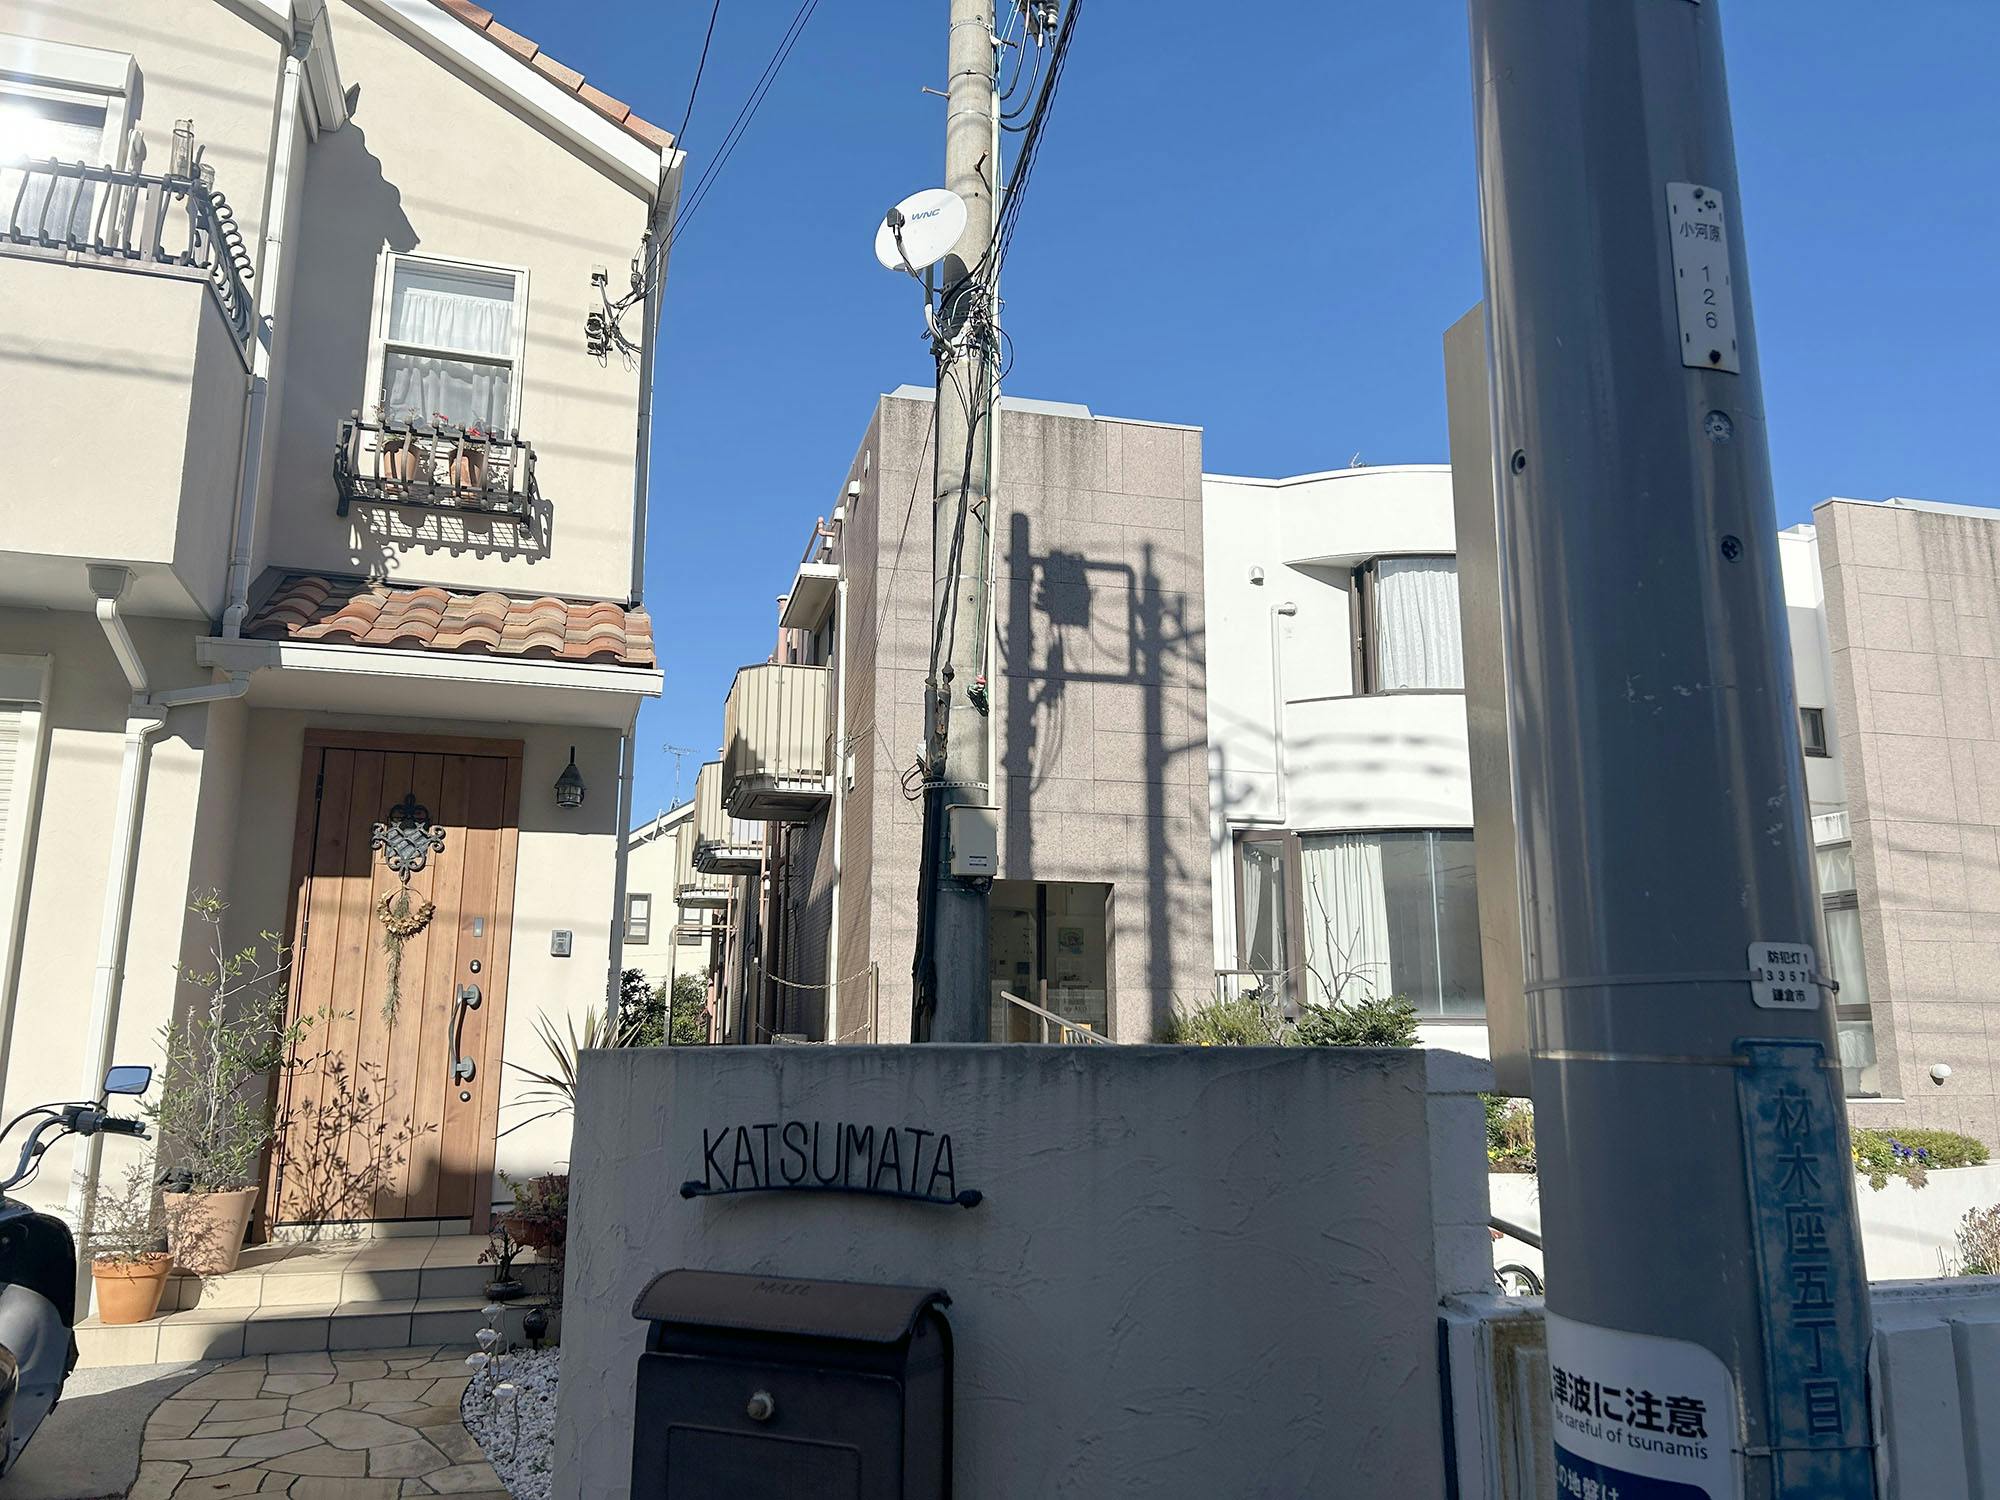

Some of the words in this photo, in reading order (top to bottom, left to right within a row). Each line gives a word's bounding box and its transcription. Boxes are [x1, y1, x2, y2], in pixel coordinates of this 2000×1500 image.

[911, 209, 940, 220] WNC
[1680, 221, 1721, 242] 小河原
[1701, 265, 1718, 329] 126
[703, 1121, 955, 1200] KATSUMATA
[1771, 1087, 1844, 1436] 材木座五丁目
[1551, 1364, 1708, 1440] 津波に注意
[1565, 1415, 1602, 1440] careful
[1606, 1428, 1622, 1444] of
[1628, 1431, 1708, 1460] tsunamis
